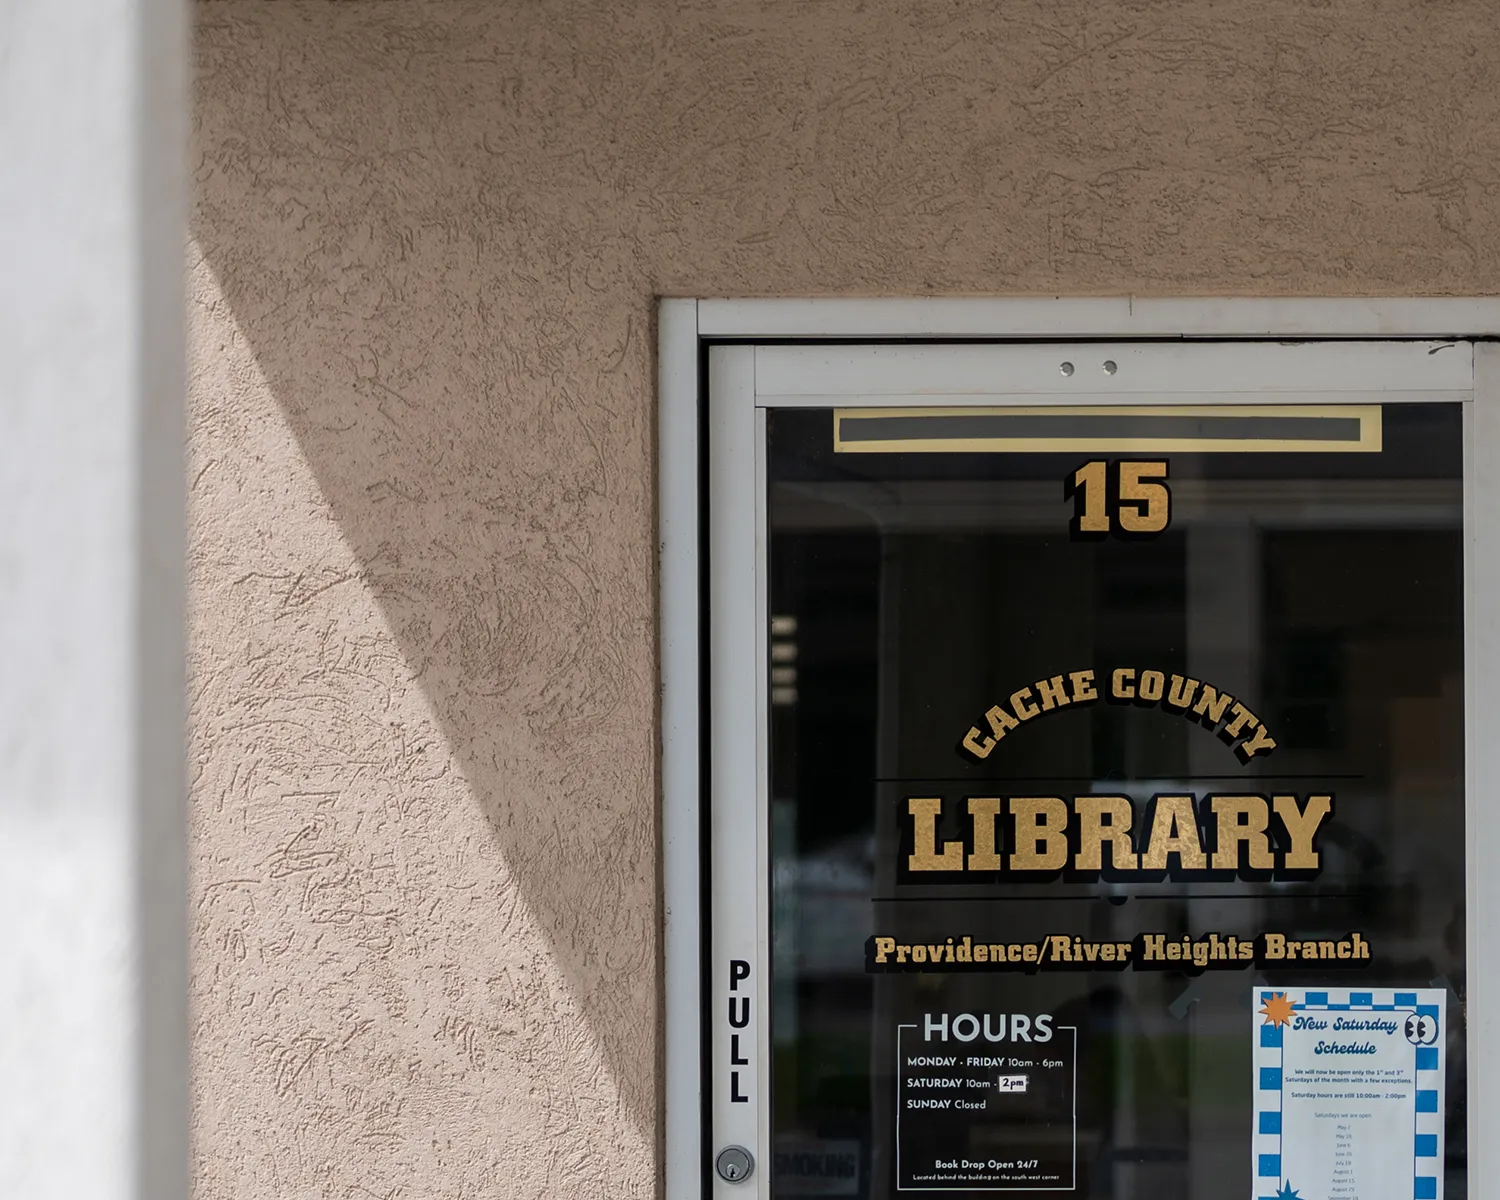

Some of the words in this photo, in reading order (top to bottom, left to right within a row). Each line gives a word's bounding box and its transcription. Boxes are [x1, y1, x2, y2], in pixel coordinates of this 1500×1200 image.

[1075, 461, 1169, 532] 15
[961, 667, 1098, 760] CACHE
[1111, 666, 1277, 760] COUNTY
[907, 795, 1332, 872] LIBRARY
[875, 935, 1132, 966] Providence/River
[1144, 934, 1254, 966] Heights
[1264, 932, 1371, 961] Branch
[728, 959, 751, 1103] PULL
[924, 1013, 1053, 1042] HOURS
[1293, 1016, 1328, 1031] New
[1333, 1016, 1398, 1035] Saturday
[1314, 1041, 1378, 1055] Schedule
[907, 1057, 957, 1066] MONDAY
[966, 1057, 1005, 1067] FRIDAY
[1008, 1058, 1033, 1067] 10am
[1042, 1059, 1063, 1068] 6pm
[907, 1079, 963, 1088] SATURDAY
[966, 1079, 990, 1088] 10am
[1002, 1078, 1024, 1090] 2pm
[907, 1100, 951, 1109] SUNDAY
[954, 1100, 986, 1109] Closed
[935, 1160, 958, 1169] Book
[962, 1160, 985, 1170] Drop
[988, 1160, 1014, 1170] Open
[1016, 1160, 1038, 1169] 24/7
